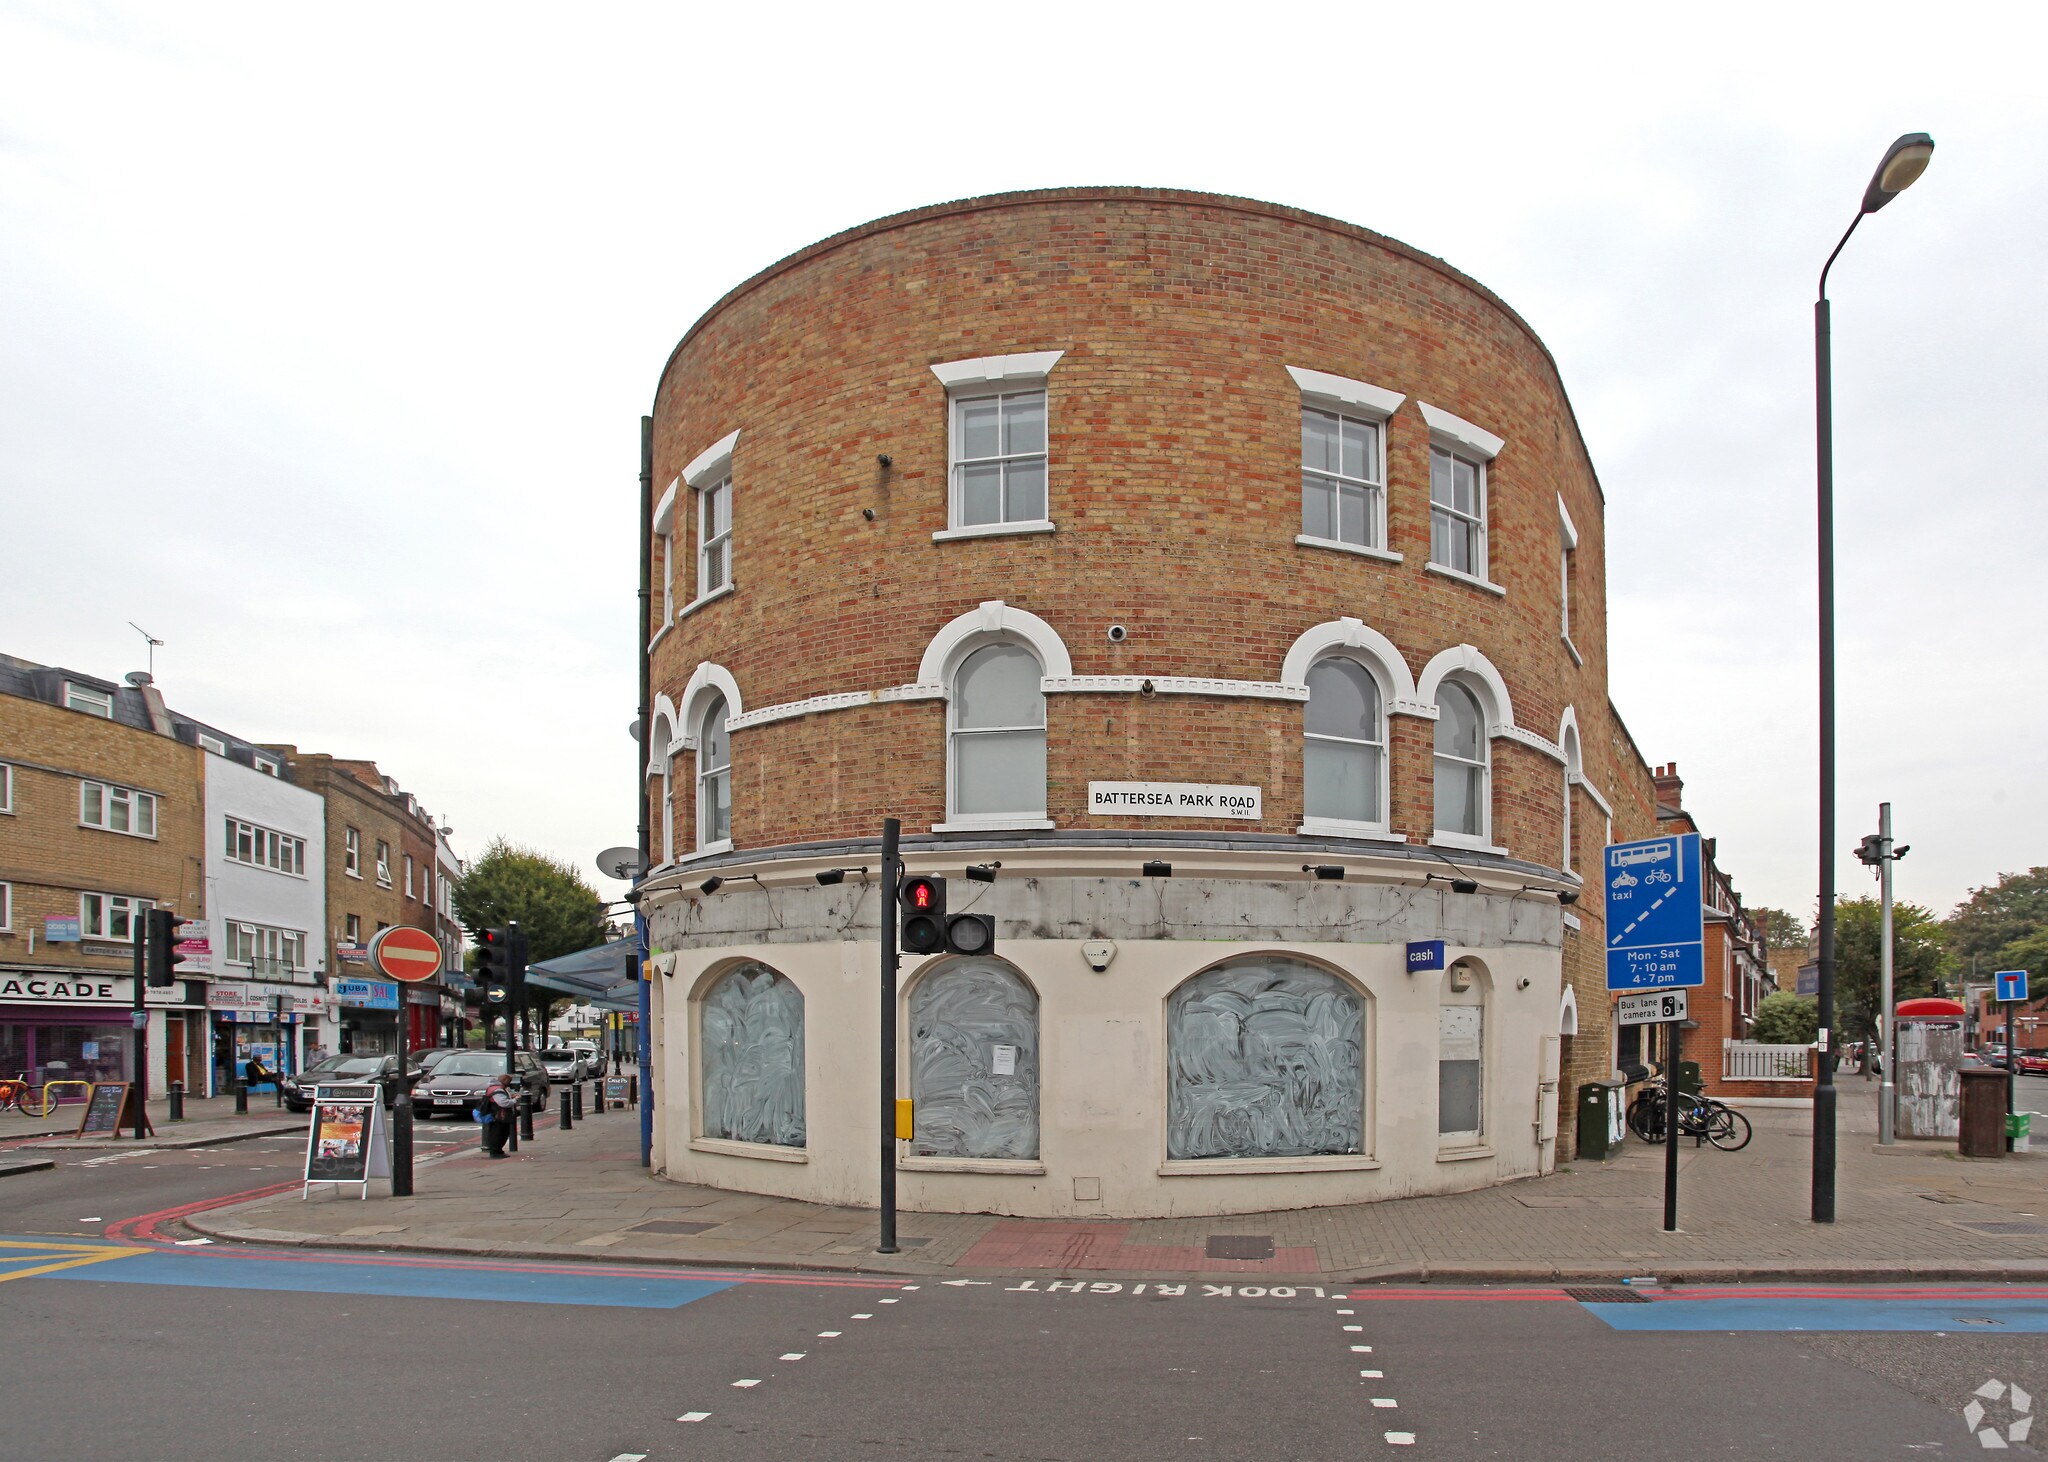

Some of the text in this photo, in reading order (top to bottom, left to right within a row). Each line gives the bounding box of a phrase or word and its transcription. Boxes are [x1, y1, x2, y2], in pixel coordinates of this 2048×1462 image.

[1095, 792, 1255, 808] BATTERSEA PARK ROAD
[1611, 890, 1632, 900] taxi
[1409, 949, 1434, 962] cash
[1627, 951, 1651, 961] Mon
[1660, 949, 1680, 959] Sat
[1621, 998, 1658, 1010] Bus lane
[1623, 1010, 1657, 1020] cameras
[1004, 1280, 1326, 1299] LOOK RIGHT
